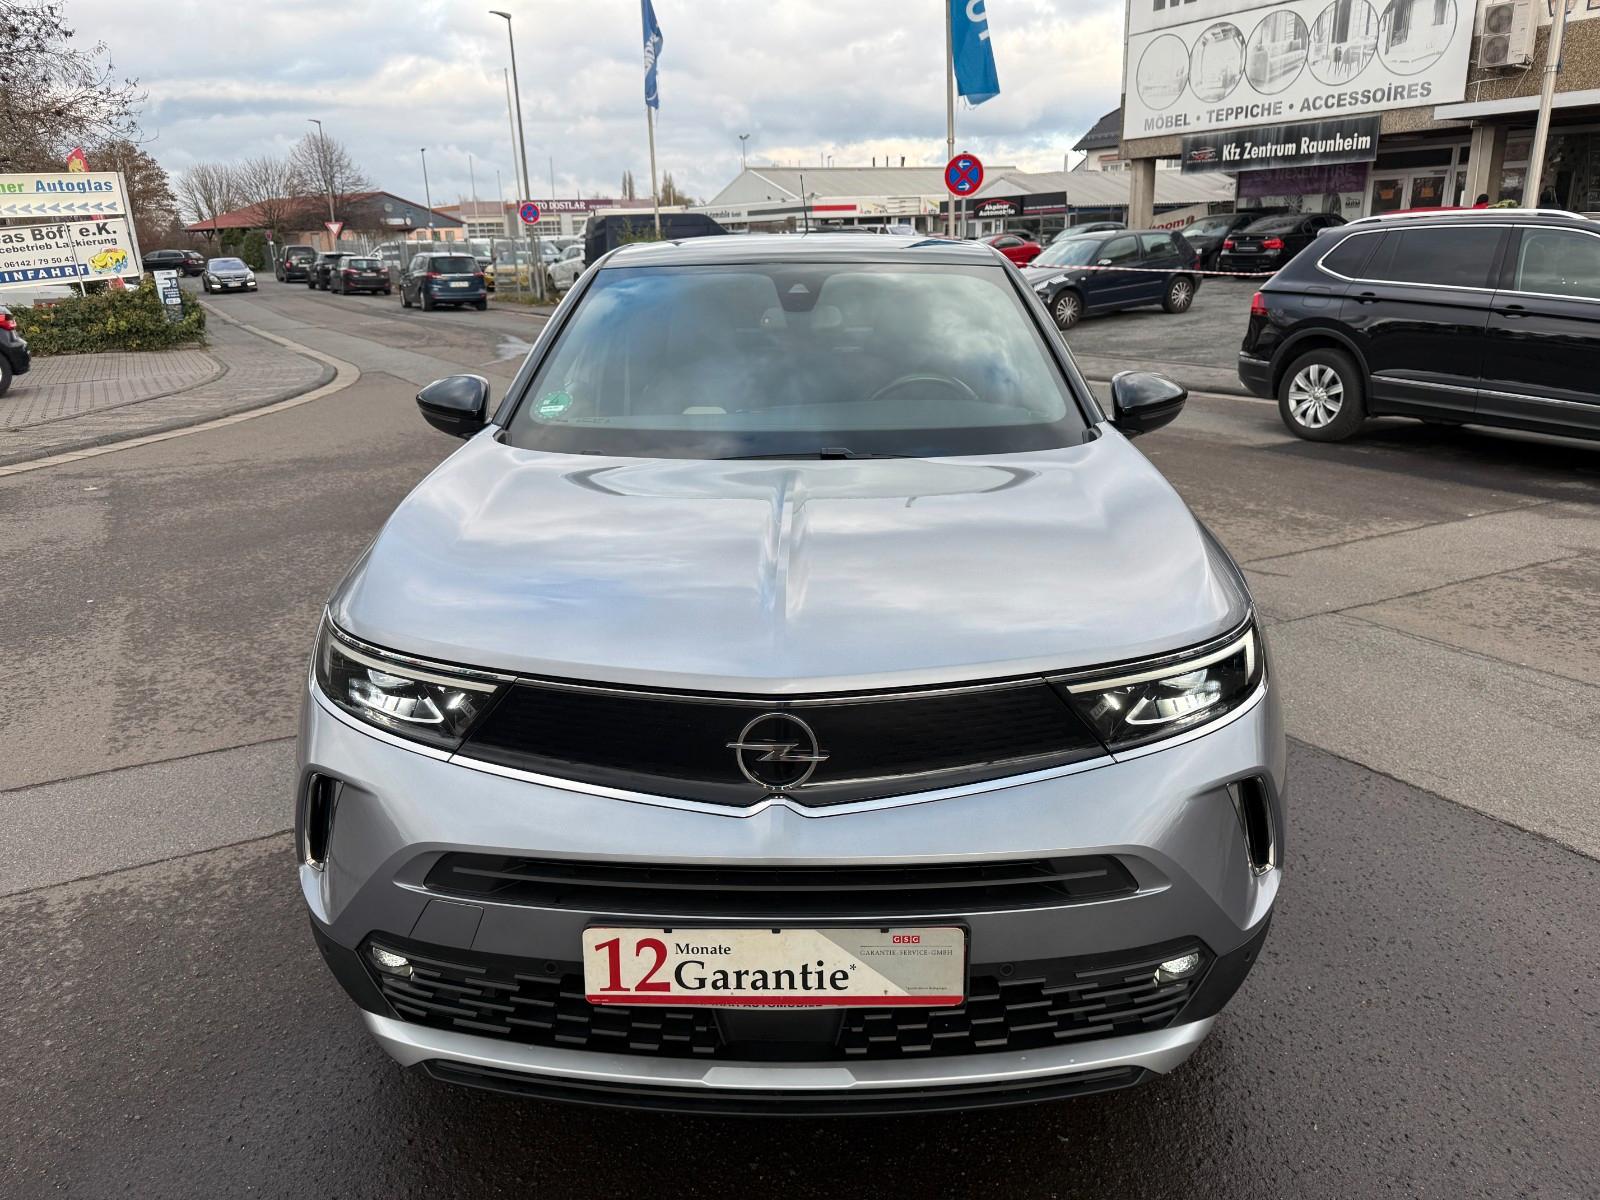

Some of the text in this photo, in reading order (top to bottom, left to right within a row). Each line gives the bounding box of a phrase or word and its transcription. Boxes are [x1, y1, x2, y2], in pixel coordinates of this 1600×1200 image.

[1144, 112, 1191, 131] MÖBEL
[1206, 101, 1283, 124] TEPPICHE
[1222, 132, 1371, 161] Kfz Zentrum Raunheim
[35, 179, 113, 194] Autoglas
[549, 201, 586, 210] DOSTLAR
[79, 222, 117, 237] e.K.
[4, 259, 32, 268] 06142
[39, 257, 49, 265] 79
[51, 256, 62, 264] 50
[893, 936, 920, 944] GSG
[674, 943, 732, 955] Monate
[594, 937, 671, 993] 12
